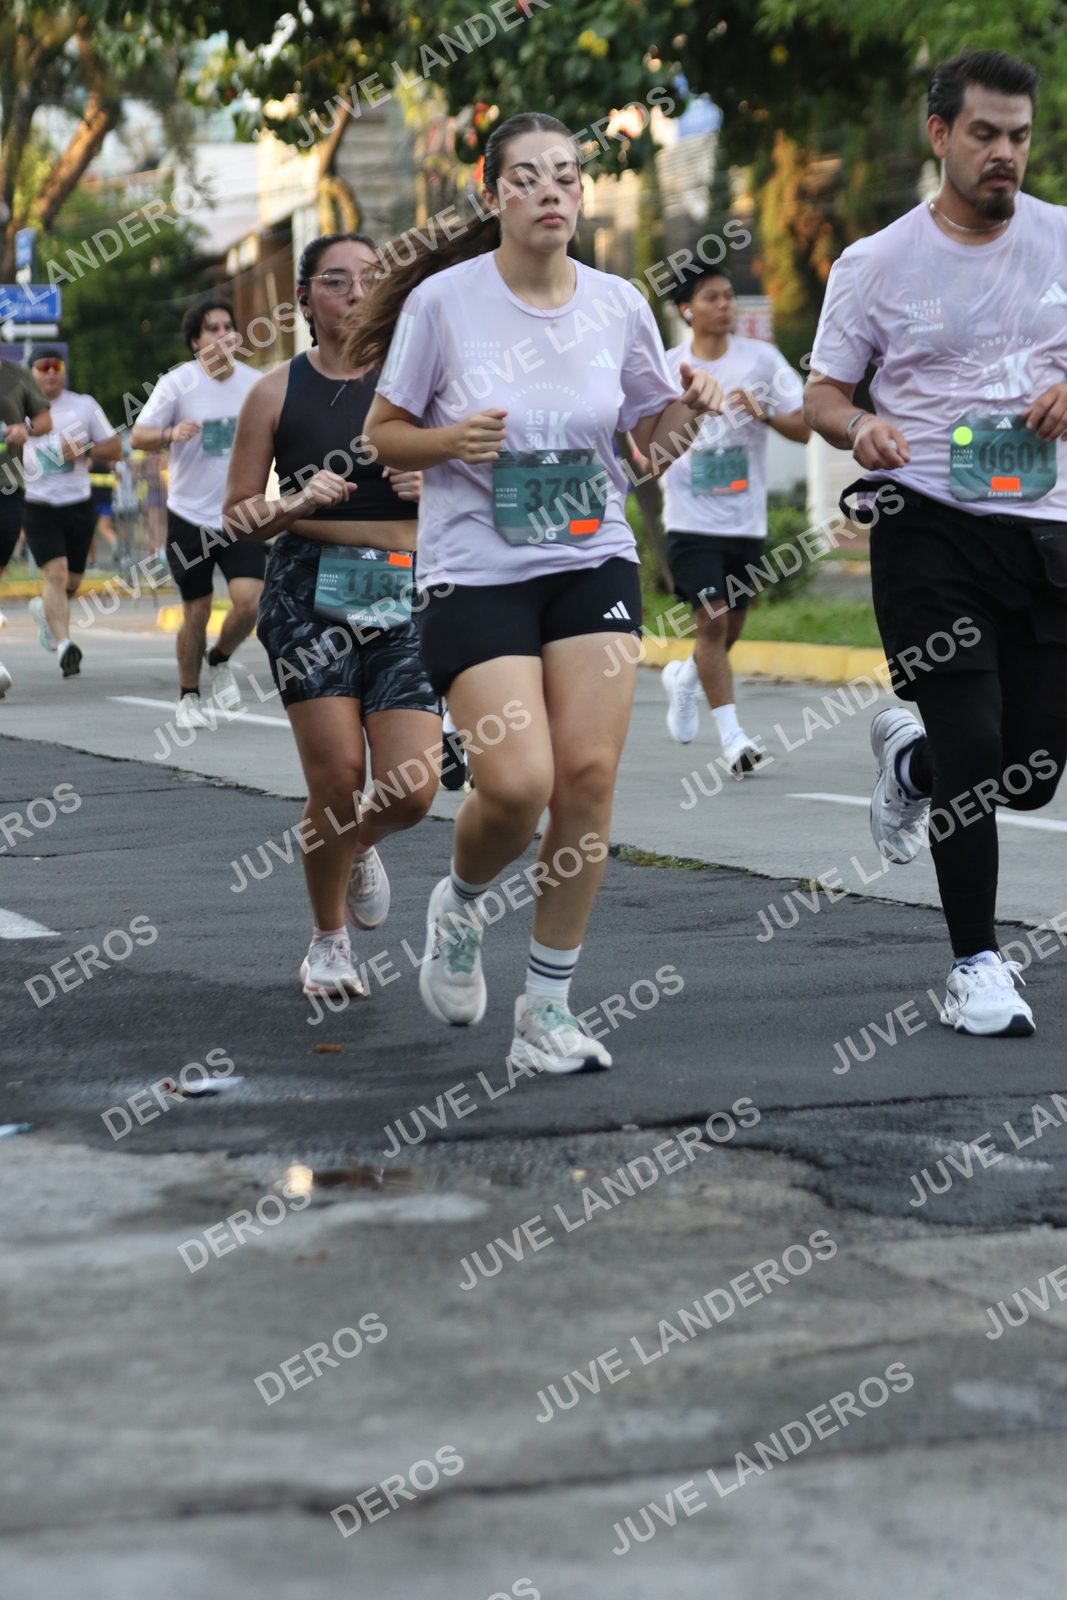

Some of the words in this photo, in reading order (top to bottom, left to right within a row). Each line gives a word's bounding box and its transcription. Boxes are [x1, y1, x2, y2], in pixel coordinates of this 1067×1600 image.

[1004, 352, 1033, 398] K
[525, 409, 545, 426] 15
[546, 411, 573, 449] K
[525, 433, 544, 449] 30
[979, 440, 1053, 474] 0601
